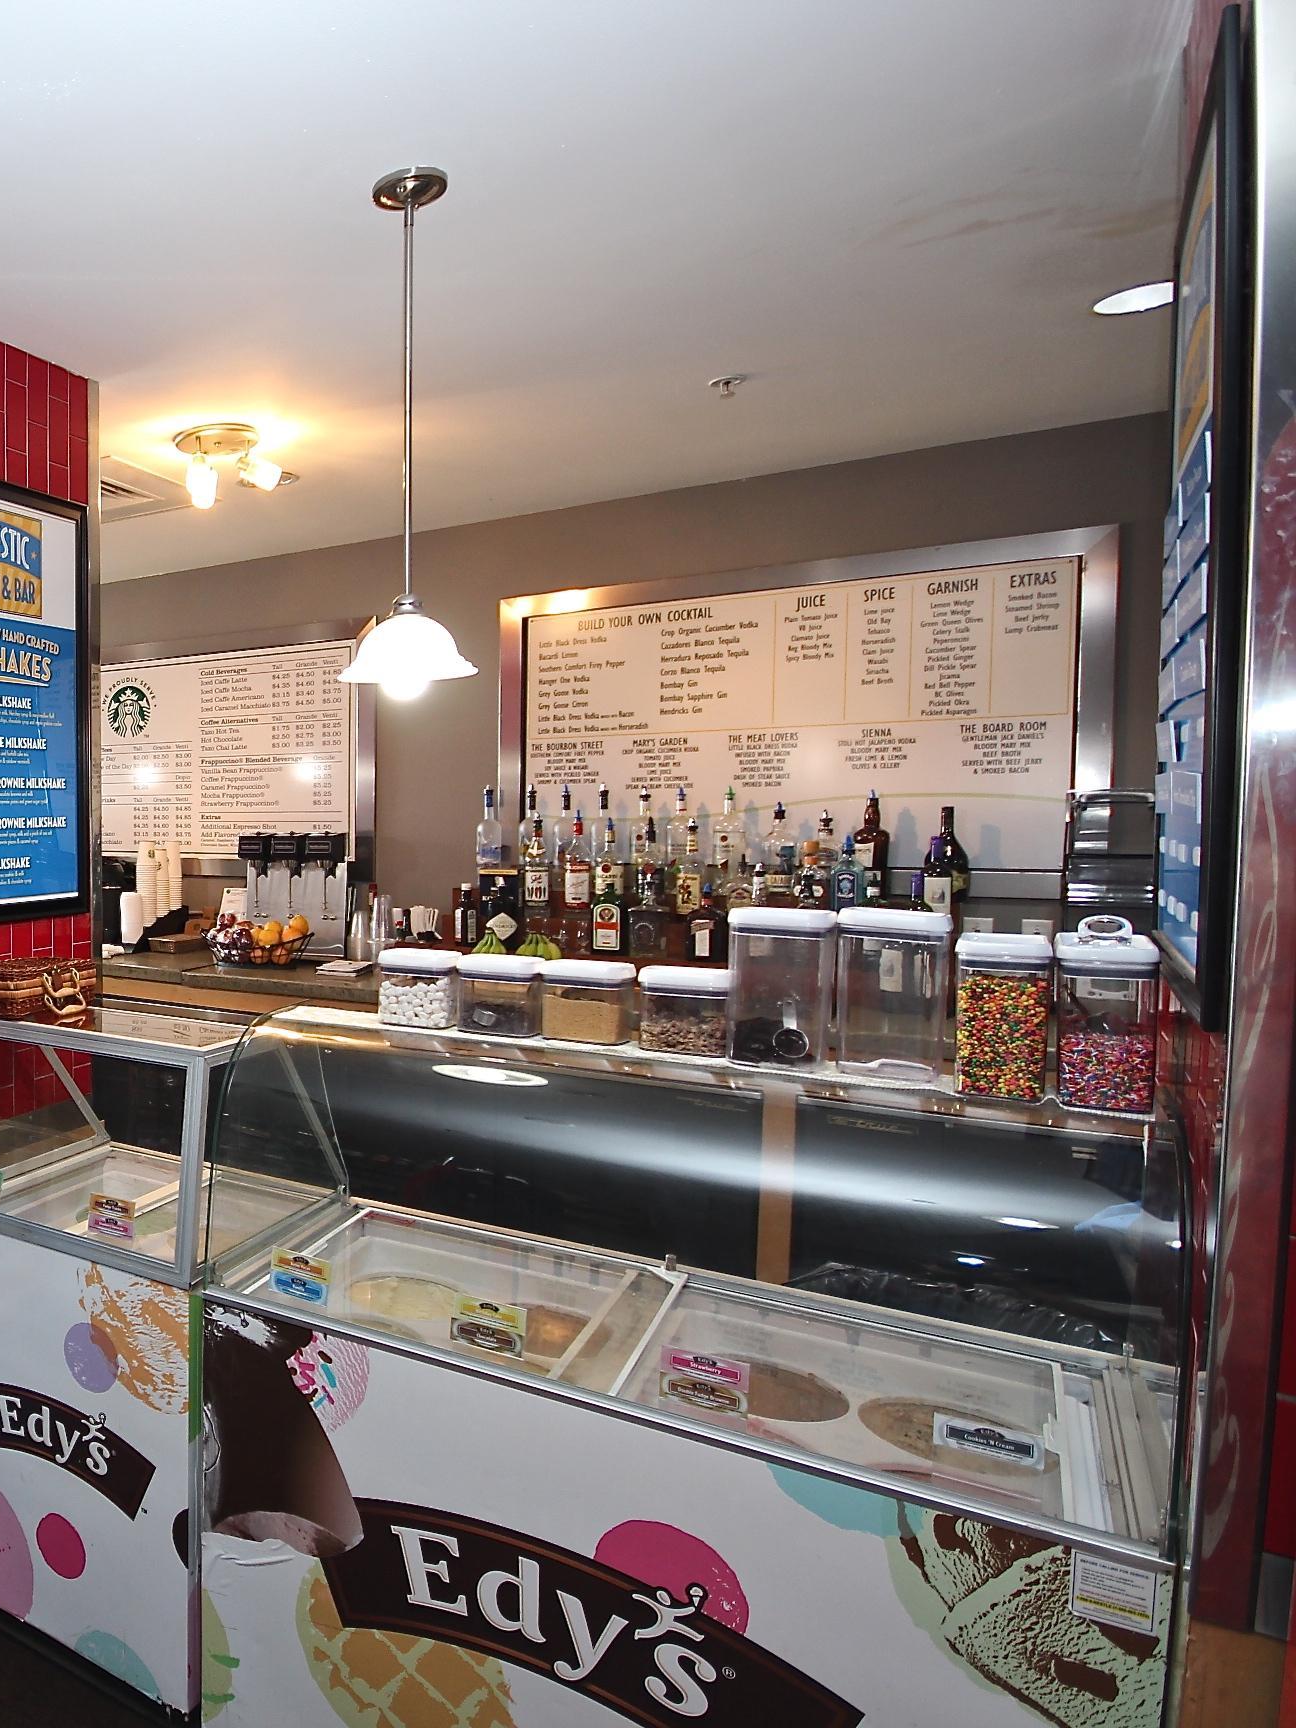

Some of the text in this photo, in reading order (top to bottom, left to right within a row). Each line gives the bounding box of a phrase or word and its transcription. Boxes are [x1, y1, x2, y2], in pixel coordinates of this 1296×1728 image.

[1010, 571, 1057, 588] EXTRAS
[2, 578, 11, 598] &
[14, 578, 35, 604] BAR
[927, 579, 978, 595] GARNISH
[864, 587, 895, 602] SPICE
[795, 594, 826, 612] JUICE
[578, 607, 713, 631] BUILD YOUR OWN COCKTAIL
[3, 629, 25, 644] HAND
[26, 635, 59, 655] CRAFTED
[695, 639, 715, 647] Blanco
[719, 636, 740, 646] Tequila
[727, 649, 749, 659] Tequila
[216, 667, 248, 675] Beverages
[102, 677, 156, 705] WE PROUDLY SERVE
[661, 681, 684, 689] Bombay
[660, 695, 683, 703] Bombay
[861, 728, 892, 738] SIENNA
[960, 721, 1047, 734] THE BOARD ROOM
[5, 736, 47, 750] MILKSHAKE
[632, 737, 688, 747] MARY'S GARDEN
[728, 732, 799, 743] THE MEAT LOVERS
[547, 742, 577, 750] BOURBON
[581, 741, 604, 750] STREET
[26, 778, 66, 789] MILKSHAKE
[27, 817, 66, 828] MILKSHAKE
[690, 1362, 722, 1375] Strawberry
[964, 1434, 987, 1444] Cookies
[995, 1442, 1015, 1450] Cream
[390, 1524, 716, 1718] Edy's
